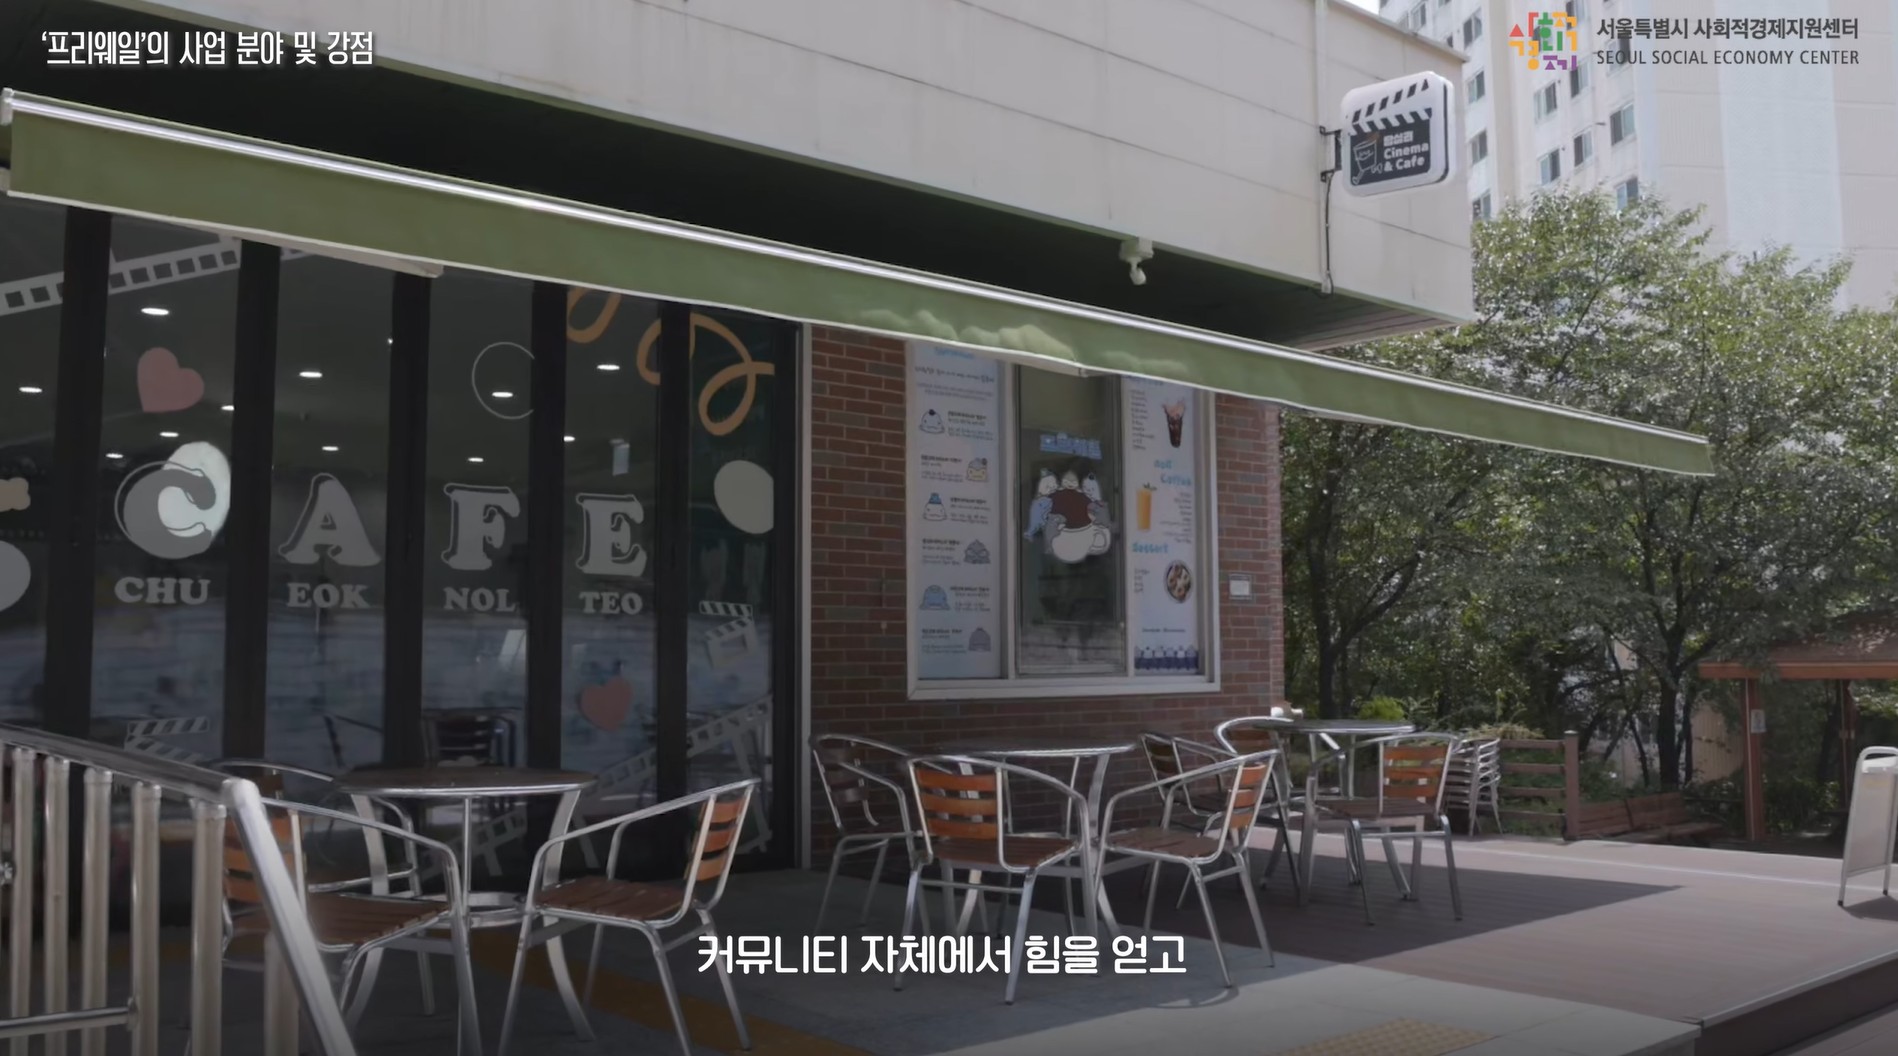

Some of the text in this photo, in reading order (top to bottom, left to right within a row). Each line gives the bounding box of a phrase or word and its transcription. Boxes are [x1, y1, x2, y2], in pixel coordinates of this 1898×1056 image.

[1384, 142, 1429, 159] Cinema
[1384, 156, 1425, 172] & Cafe
[114, 577, 643, 616] CHU EOK NOL TEO
